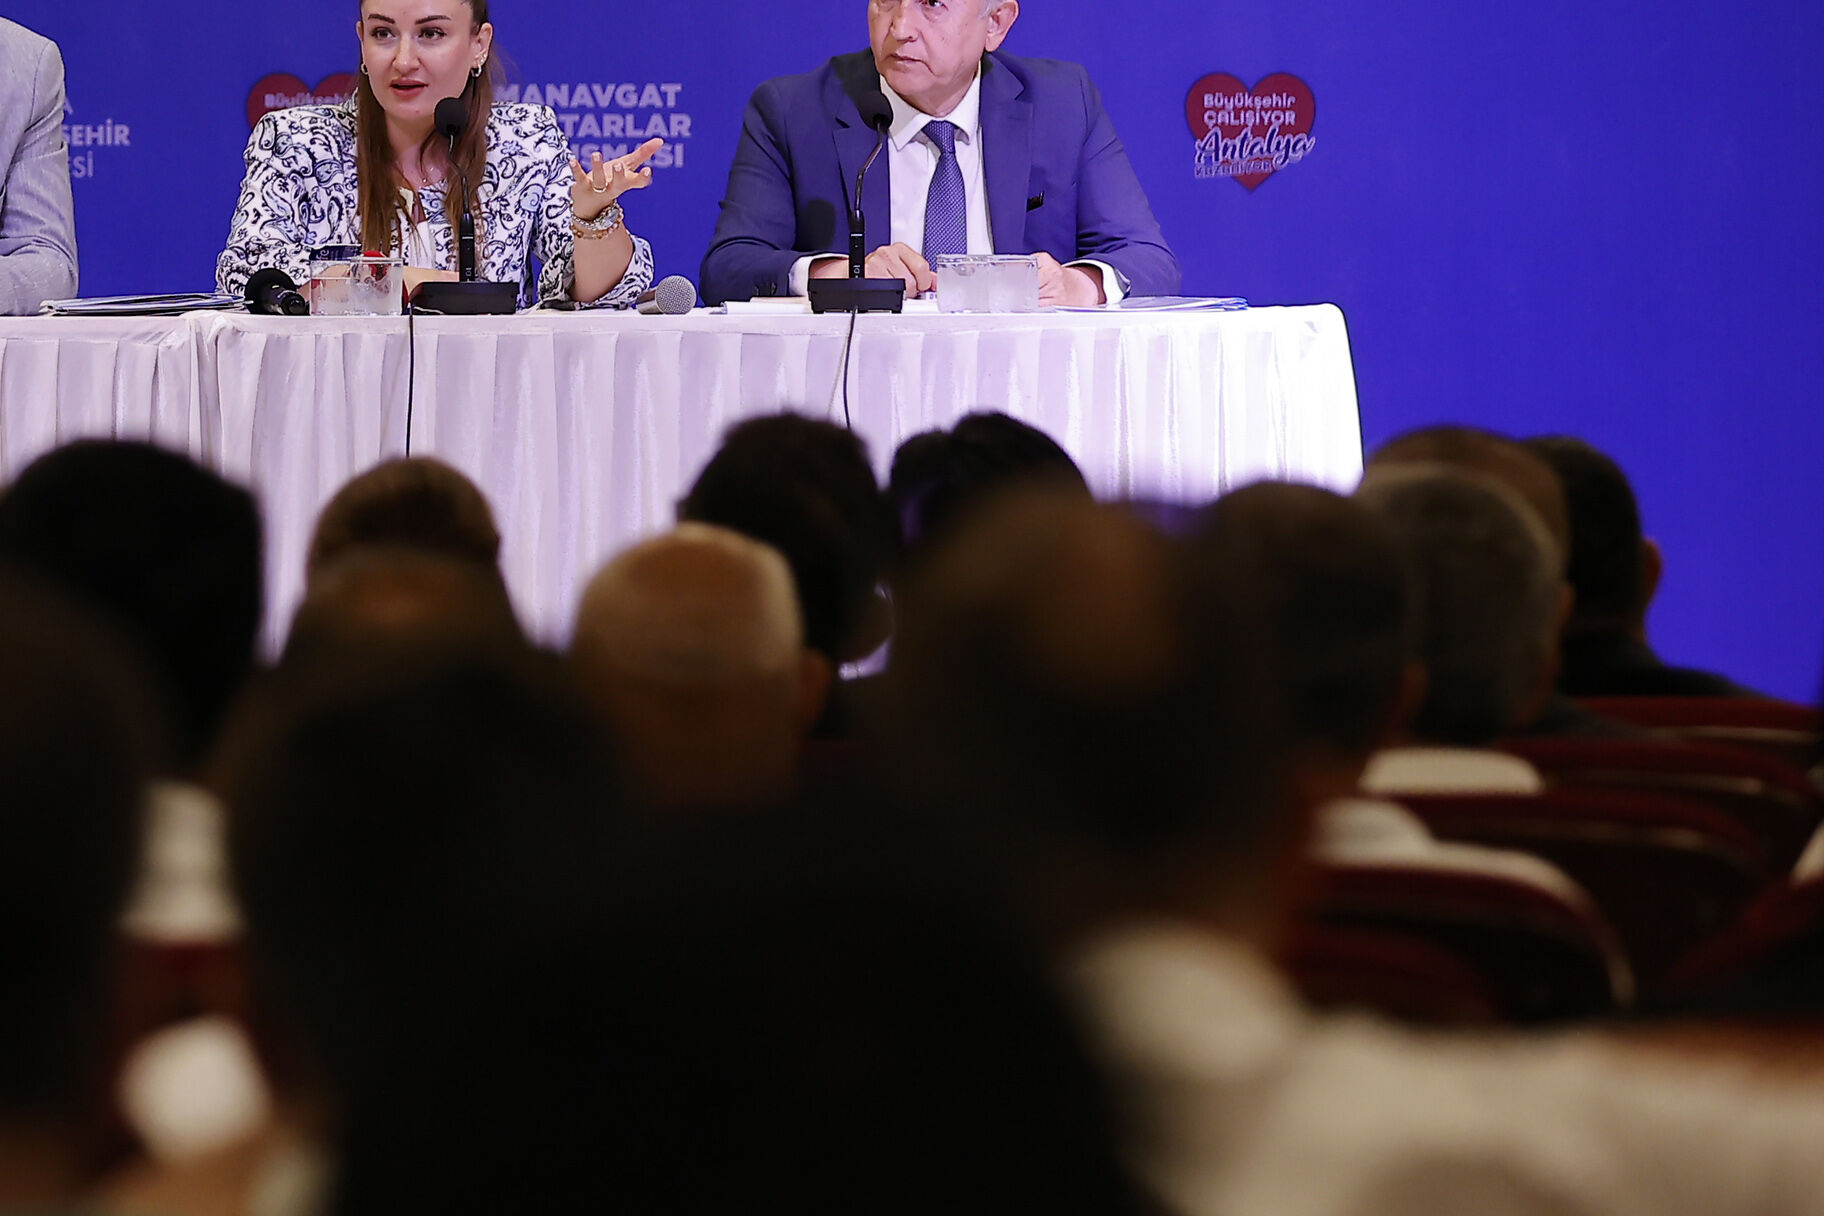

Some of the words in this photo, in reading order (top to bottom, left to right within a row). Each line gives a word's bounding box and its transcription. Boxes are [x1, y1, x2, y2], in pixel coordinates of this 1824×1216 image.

[1204, 92, 1296, 111] Büyükşehir
[558, 113, 692, 138] TARLAR
[1195, 126, 1316, 169] Antalya
